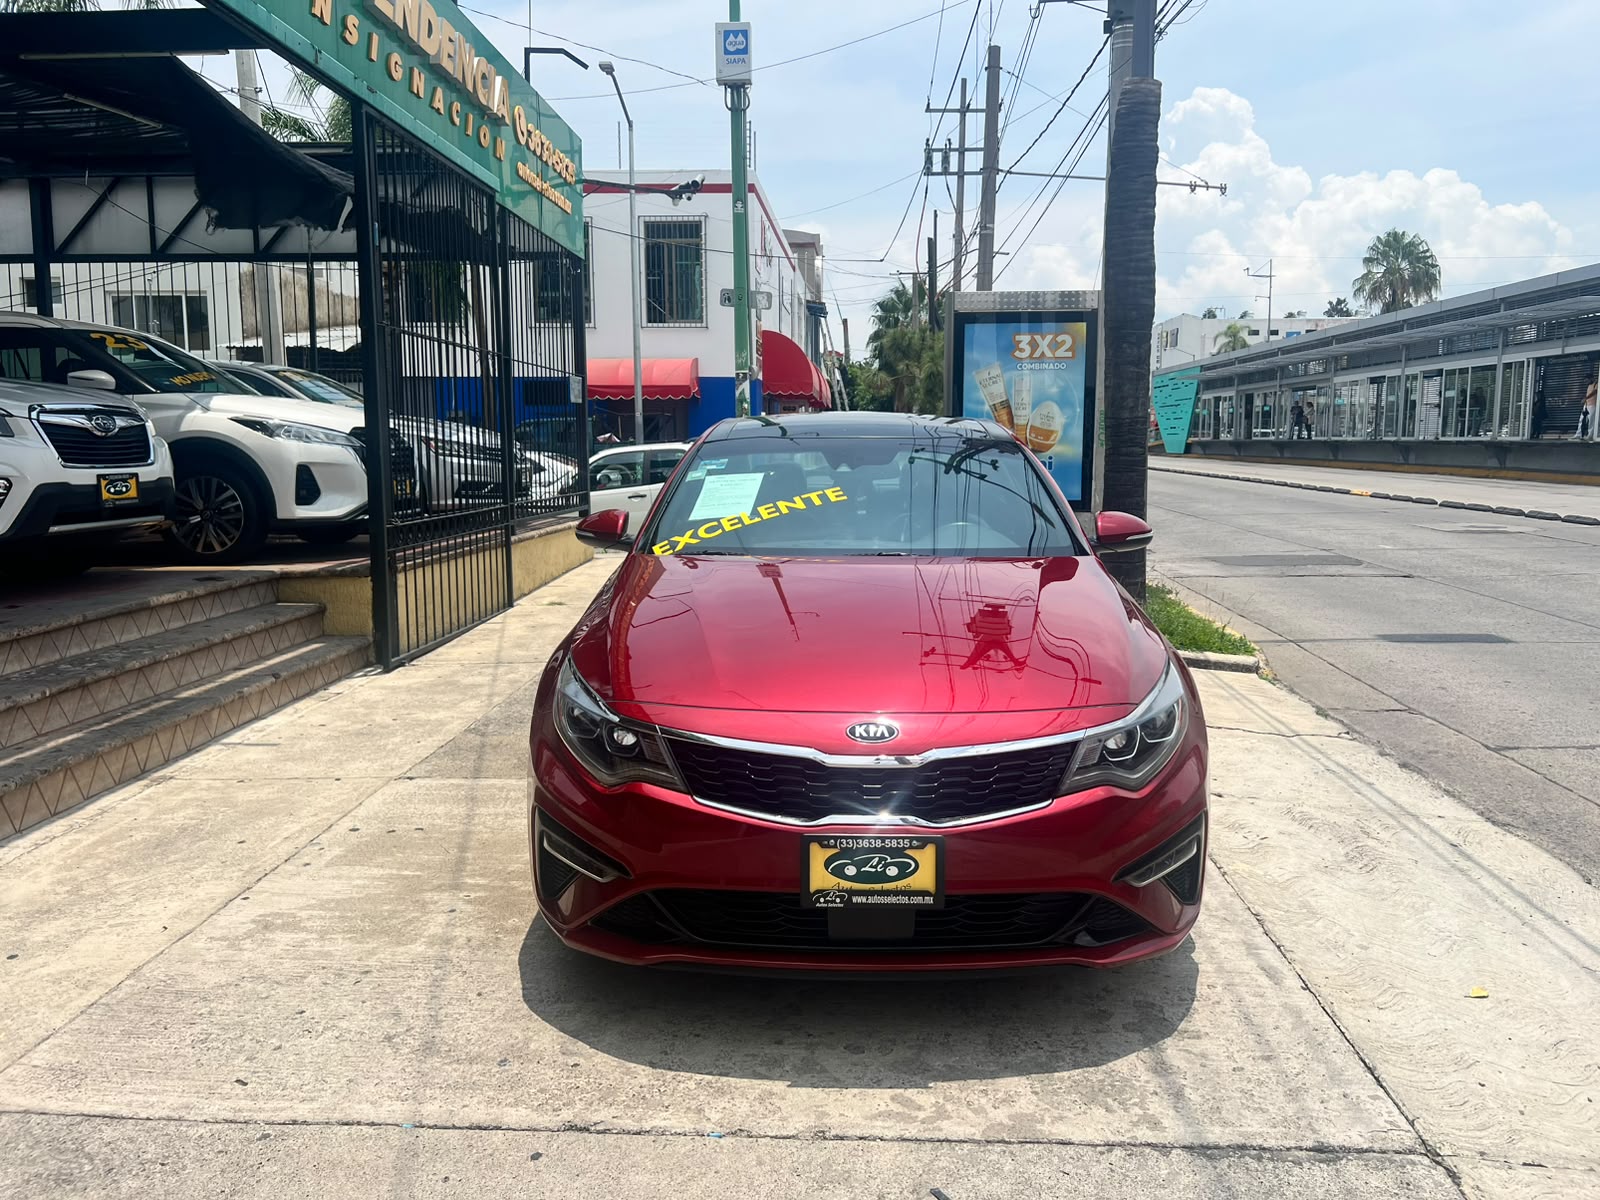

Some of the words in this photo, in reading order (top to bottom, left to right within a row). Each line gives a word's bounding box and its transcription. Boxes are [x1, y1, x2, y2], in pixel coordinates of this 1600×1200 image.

[726, 57, 746, 65] SIAPA
[1013, 334, 1073, 358] 3X2
[1016, 362, 1067, 371] COMBINADO
[651, 486, 848, 556] EXCELENTE
[854, 724, 890, 737] KIA
[837, 839, 910, 849] (33)3638-5835
[860, 857, 885, 872] Li
[852, 894, 934, 904] www.autosselectos.com.mx
